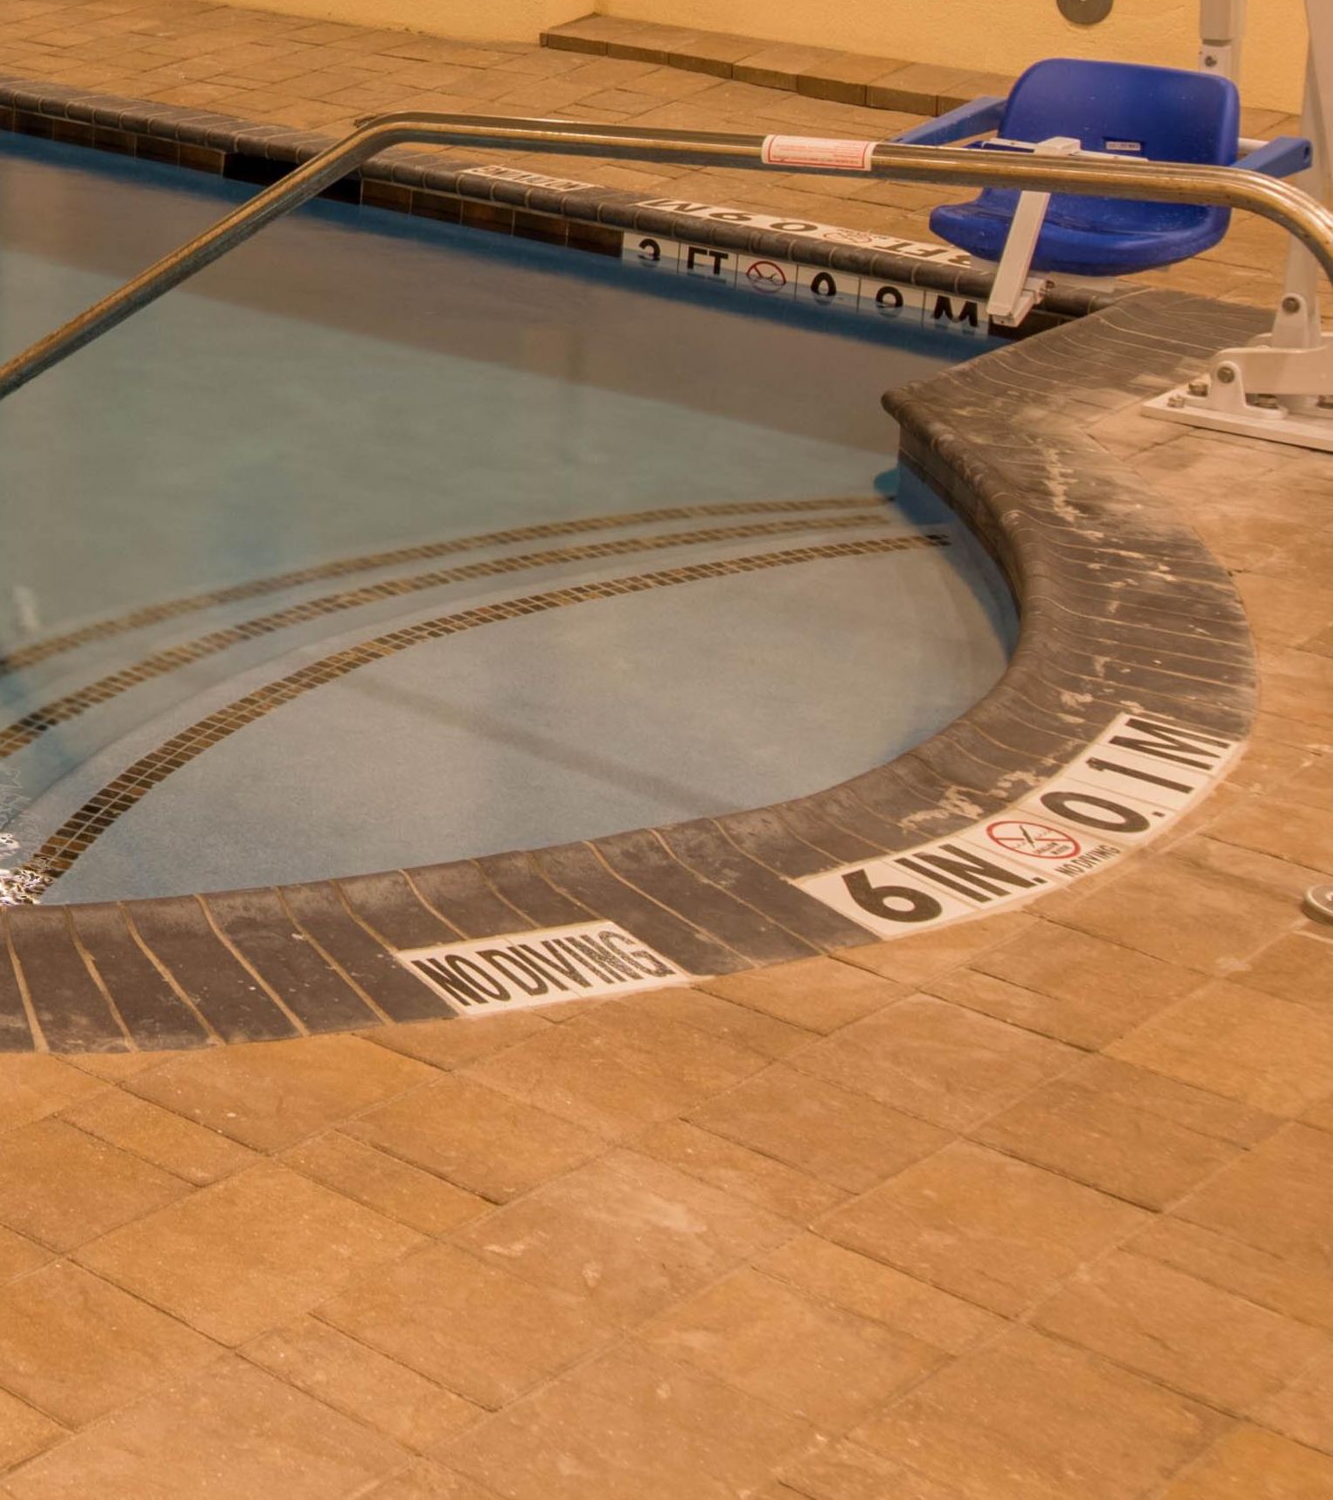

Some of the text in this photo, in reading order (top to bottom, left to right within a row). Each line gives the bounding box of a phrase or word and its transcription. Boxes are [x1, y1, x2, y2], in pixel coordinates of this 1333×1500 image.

[841, 869, 944, 923] 6
[893, 843, 1048, 904] IN.
[1108, 718, 1232, 771] M
[1054, 863, 1085, 877] NO
[1070, 845, 1121, 868] DIVING
[410, 930, 677, 1006] NO DIVING
